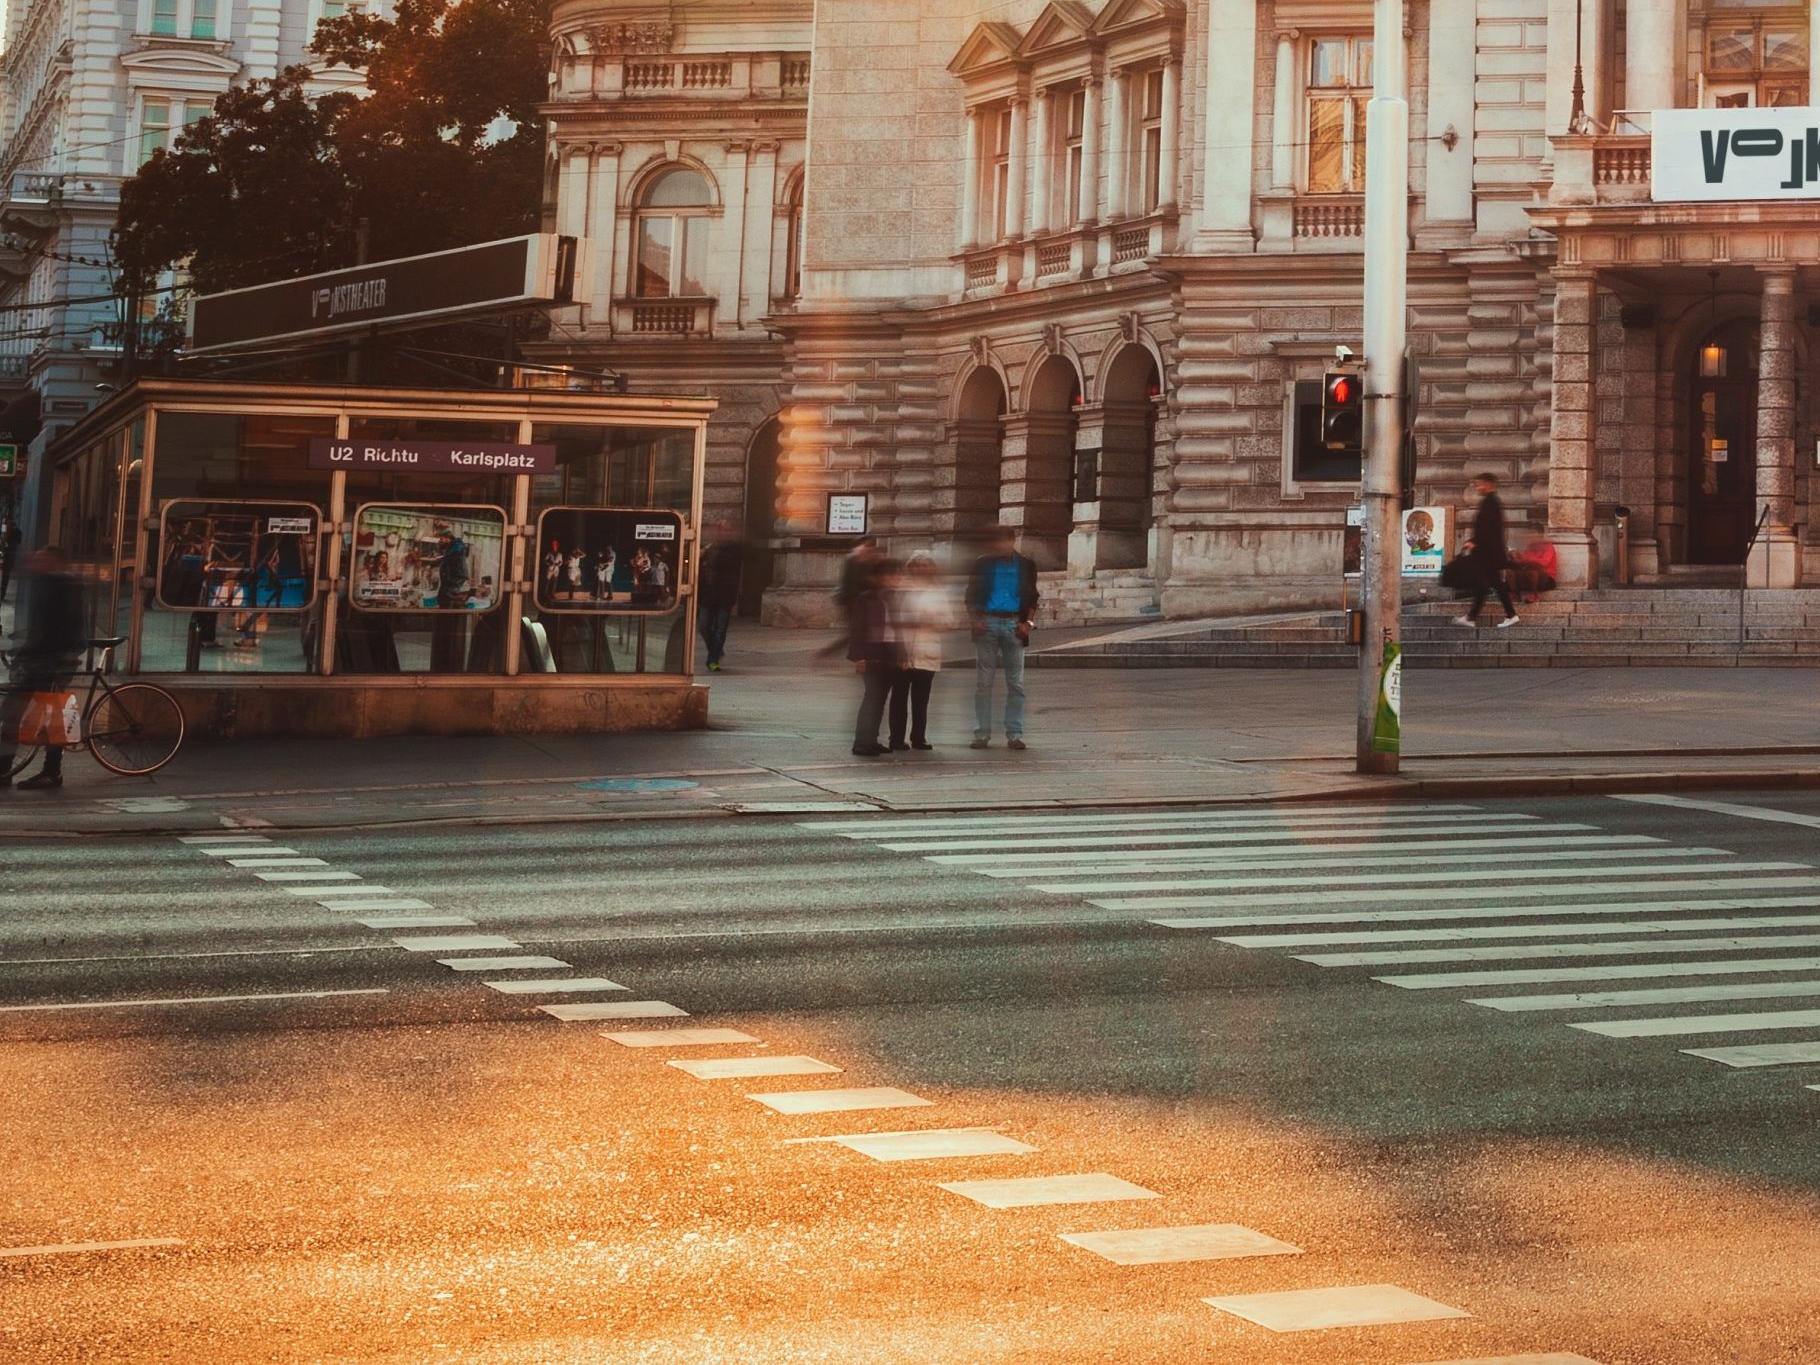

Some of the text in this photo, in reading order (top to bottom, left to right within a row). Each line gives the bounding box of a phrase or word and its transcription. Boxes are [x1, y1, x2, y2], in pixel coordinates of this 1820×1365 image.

[312, 279, 387, 318] VOLKSTHEATER
[330, 447, 353, 461] U2
[451, 451, 535, 468] Karlsplatz
